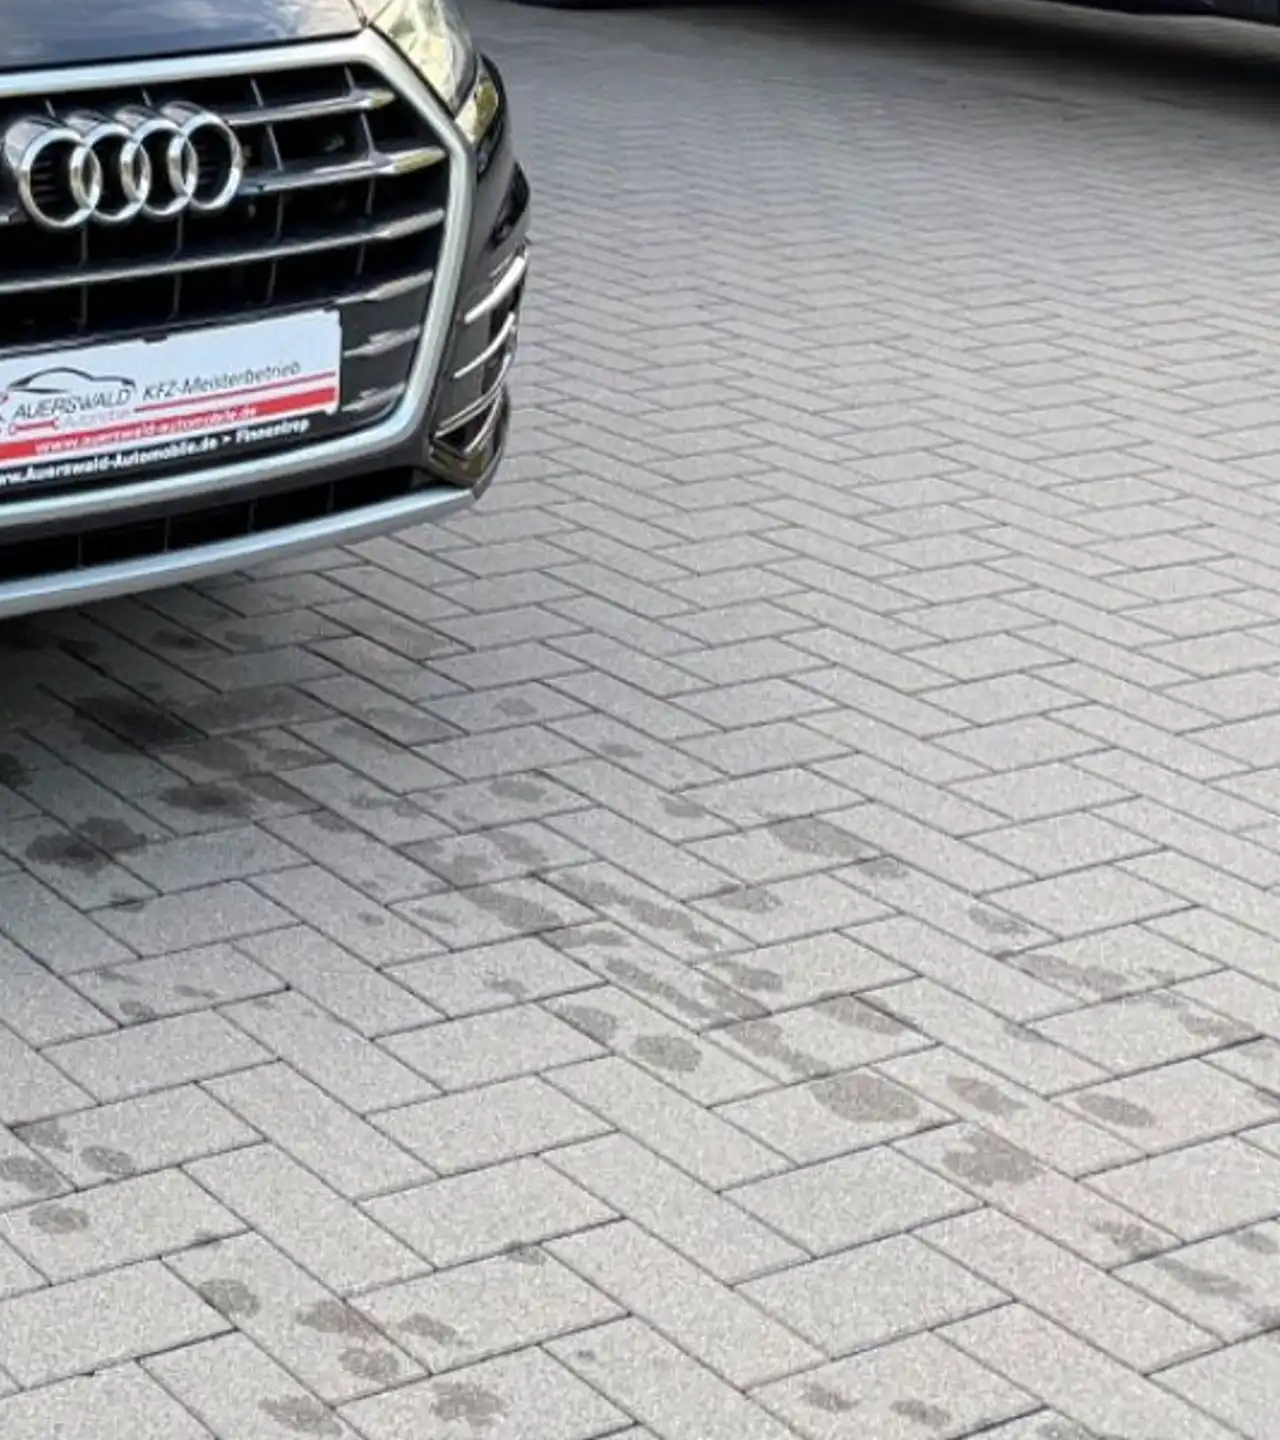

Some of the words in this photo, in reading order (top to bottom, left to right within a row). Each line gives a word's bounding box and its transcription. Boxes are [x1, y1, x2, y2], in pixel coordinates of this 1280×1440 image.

[142, 361, 301, 402] KFZ-Meisterbetrieb
[13, 387, 131, 422] AUERSWALD
[235, 417, 311, 445] Finnentrop
